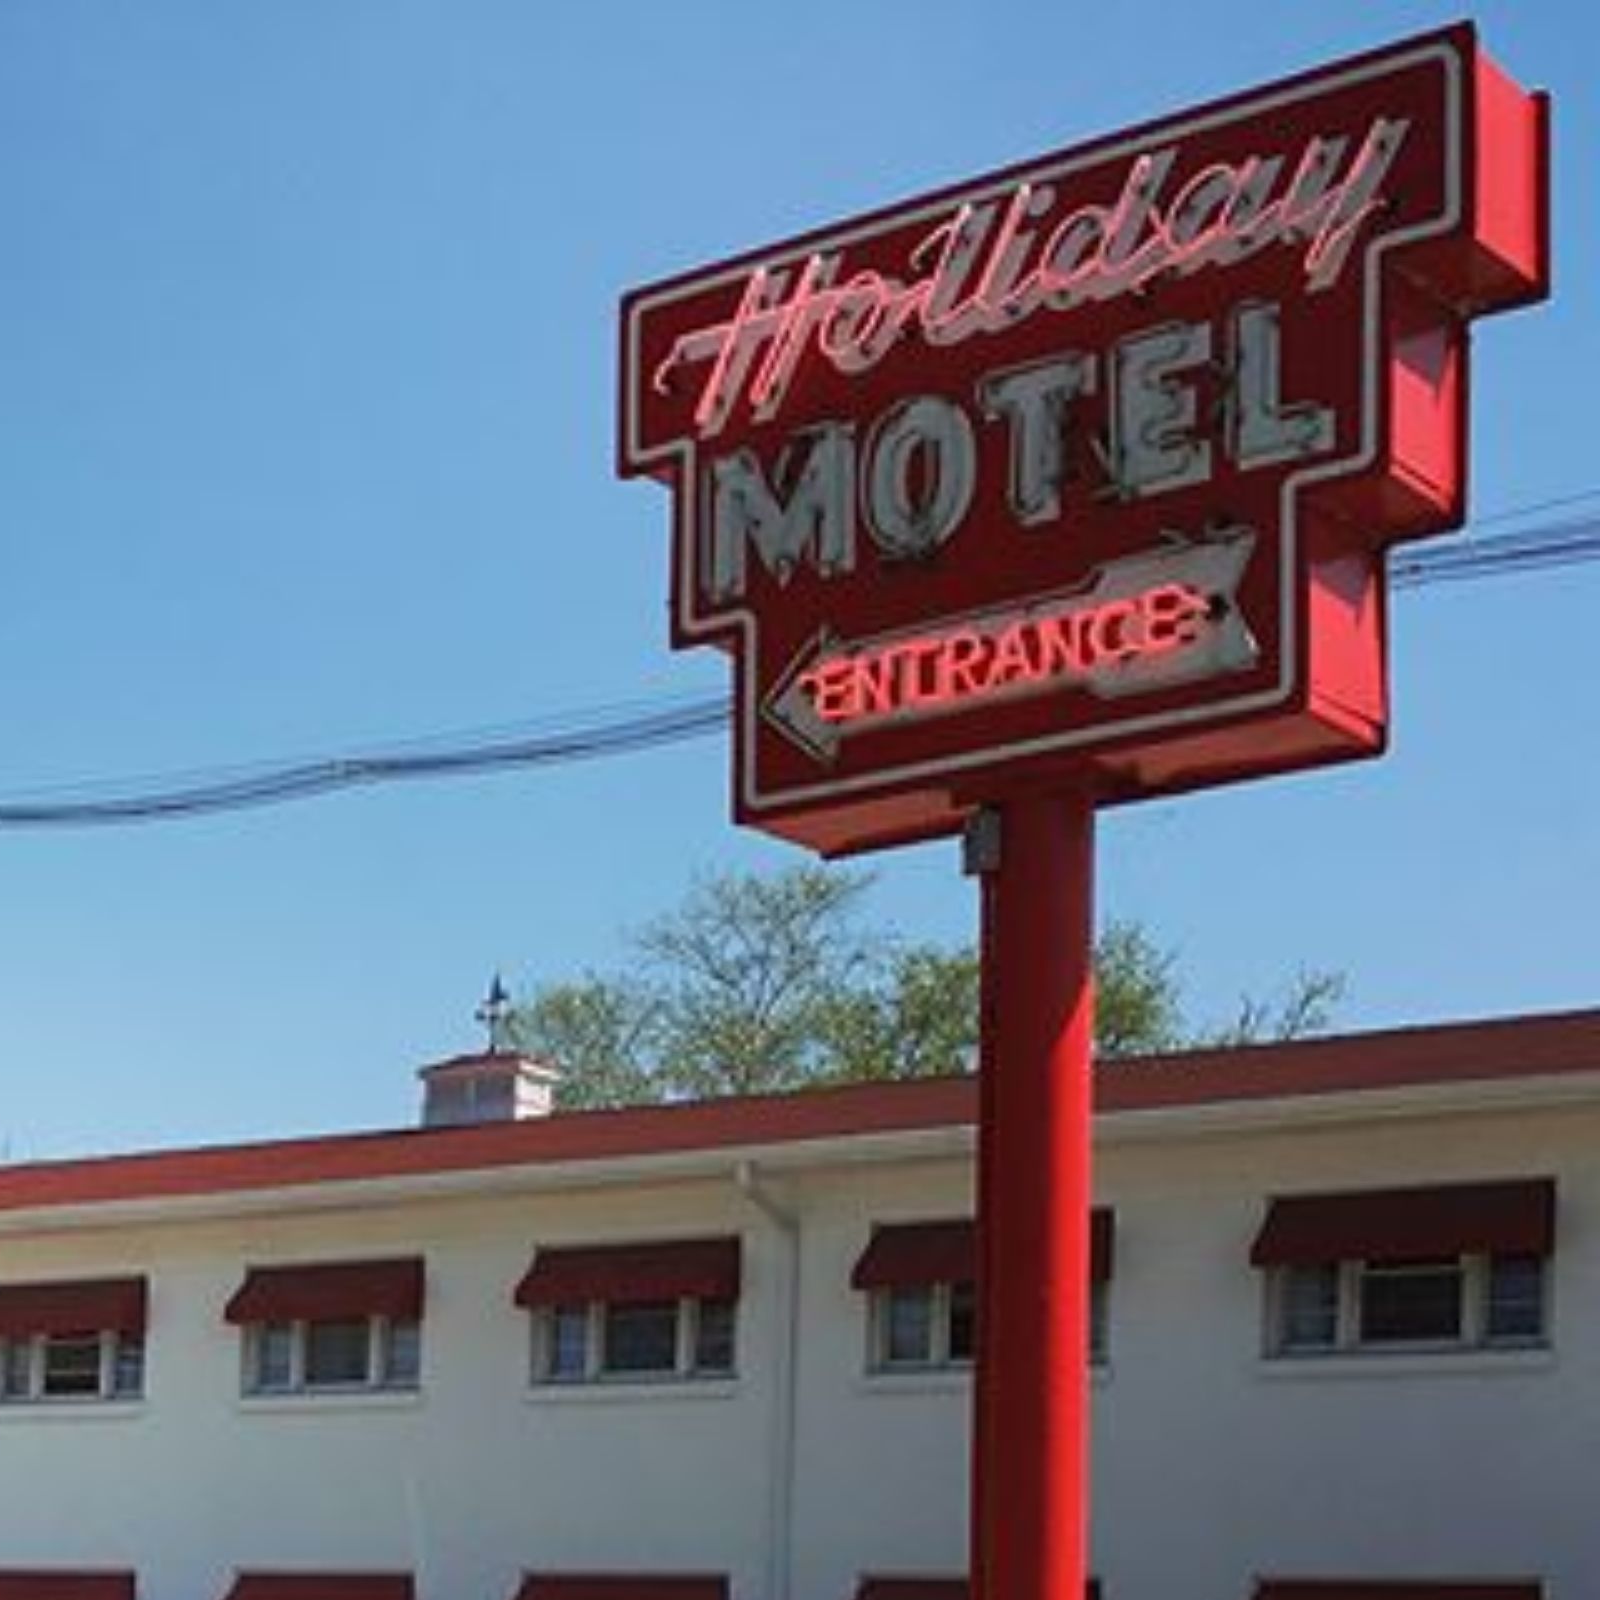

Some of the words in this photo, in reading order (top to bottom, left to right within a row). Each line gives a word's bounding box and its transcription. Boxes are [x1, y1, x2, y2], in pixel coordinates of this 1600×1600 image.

[656, 117, 1409, 436] Holiday
[700, 301, 1337, 602] MOTEL
[801, 581, 1210, 721] ENTRANCE
